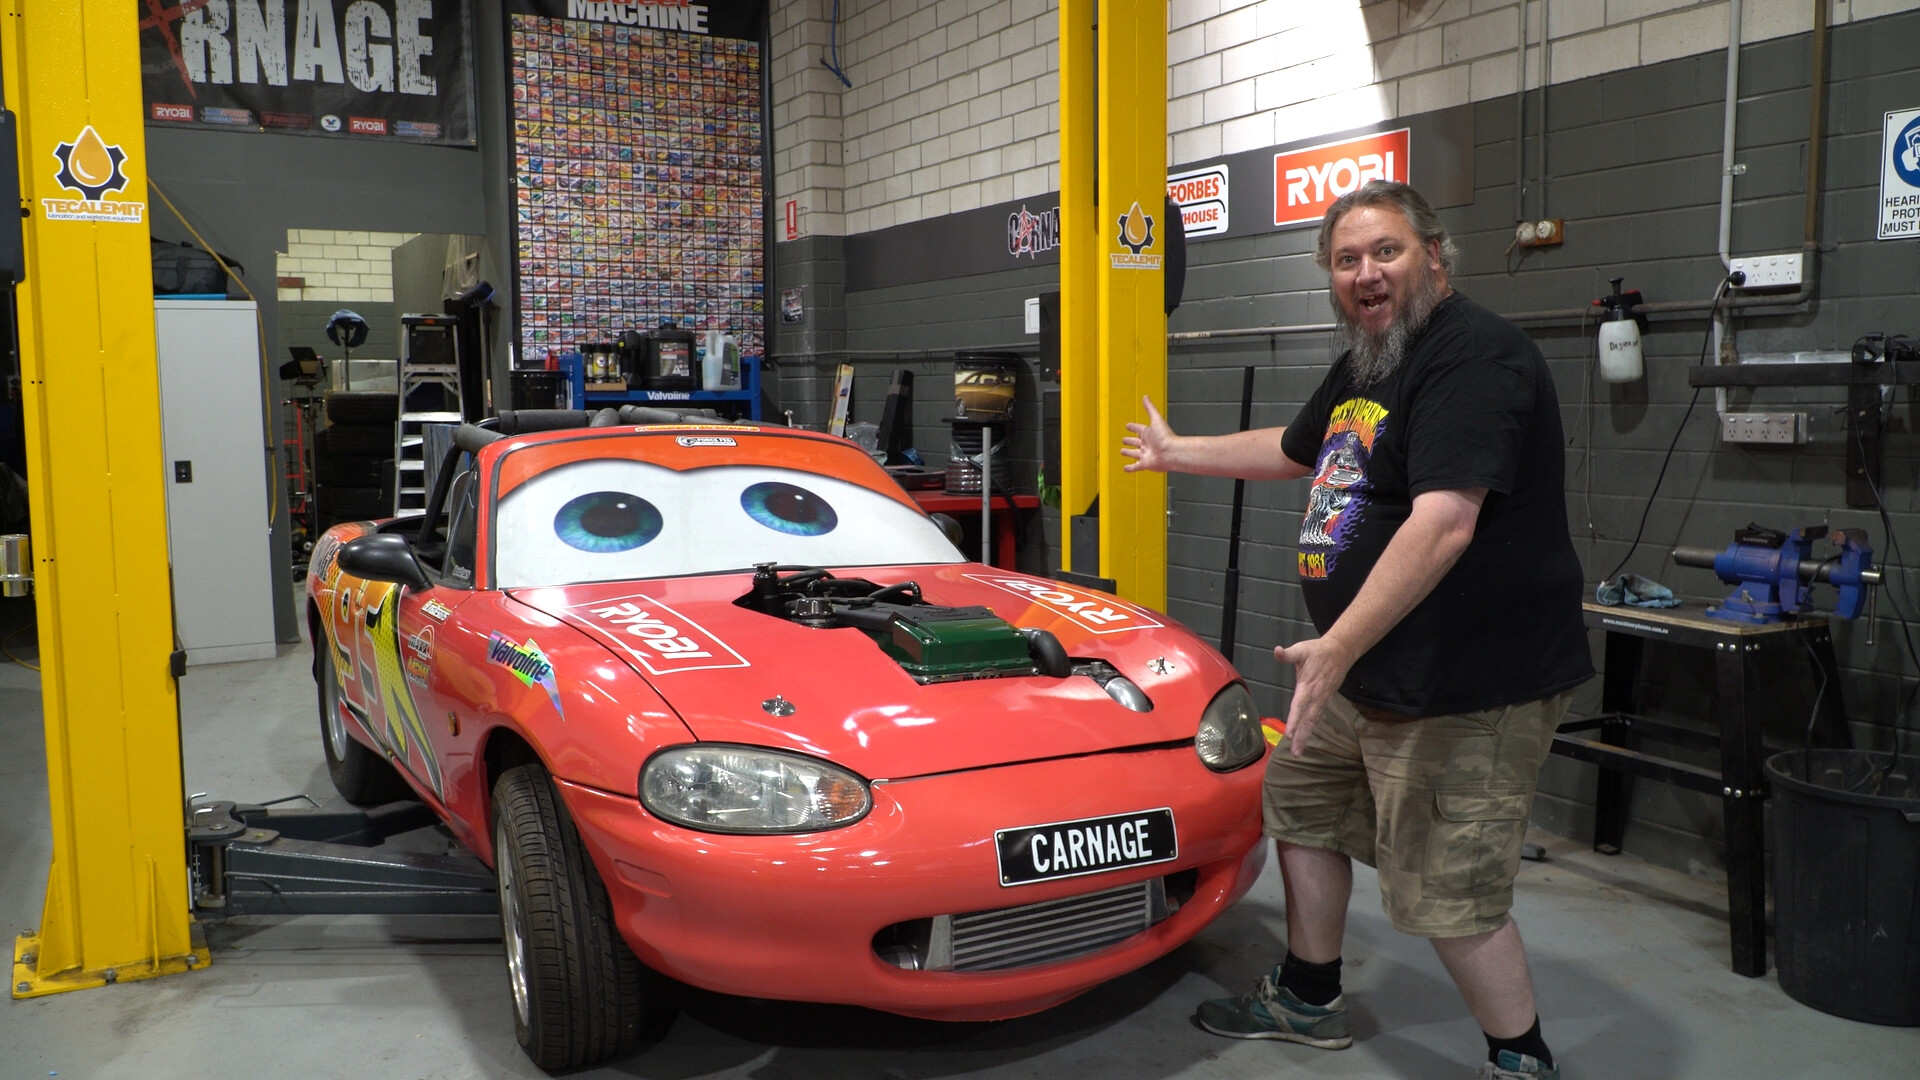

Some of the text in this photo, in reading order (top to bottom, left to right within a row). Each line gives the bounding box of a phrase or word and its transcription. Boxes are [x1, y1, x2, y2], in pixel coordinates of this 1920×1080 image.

[567, 0, 709, 34] MACHINE
[140, 0, 437, 99] RNAGE
[156, 106, 191, 119] RYOBI
[353, 120, 385, 132] RYOBI
[1168, 176, 1219, 203] FORBES
[1285, 150, 1394, 207] RYOBI
[43, 200, 143, 216] TECALEMIT
[1181, 208, 1219, 225] HOUSE
[1883, 220, 1916, 233] MUST
[1111, 254, 1162, 265] TECALEMIT
[646, 391, 691, 401] Valvoline
[1307, 552, 1327, 578] 1981
[991, 578, 1130, 625] RYOBI
[590, 603, 713, 660] RYOBI
[491, 637, 552, 682] Valvoline
[1031, 818, 1153, 874] CARNAGE
